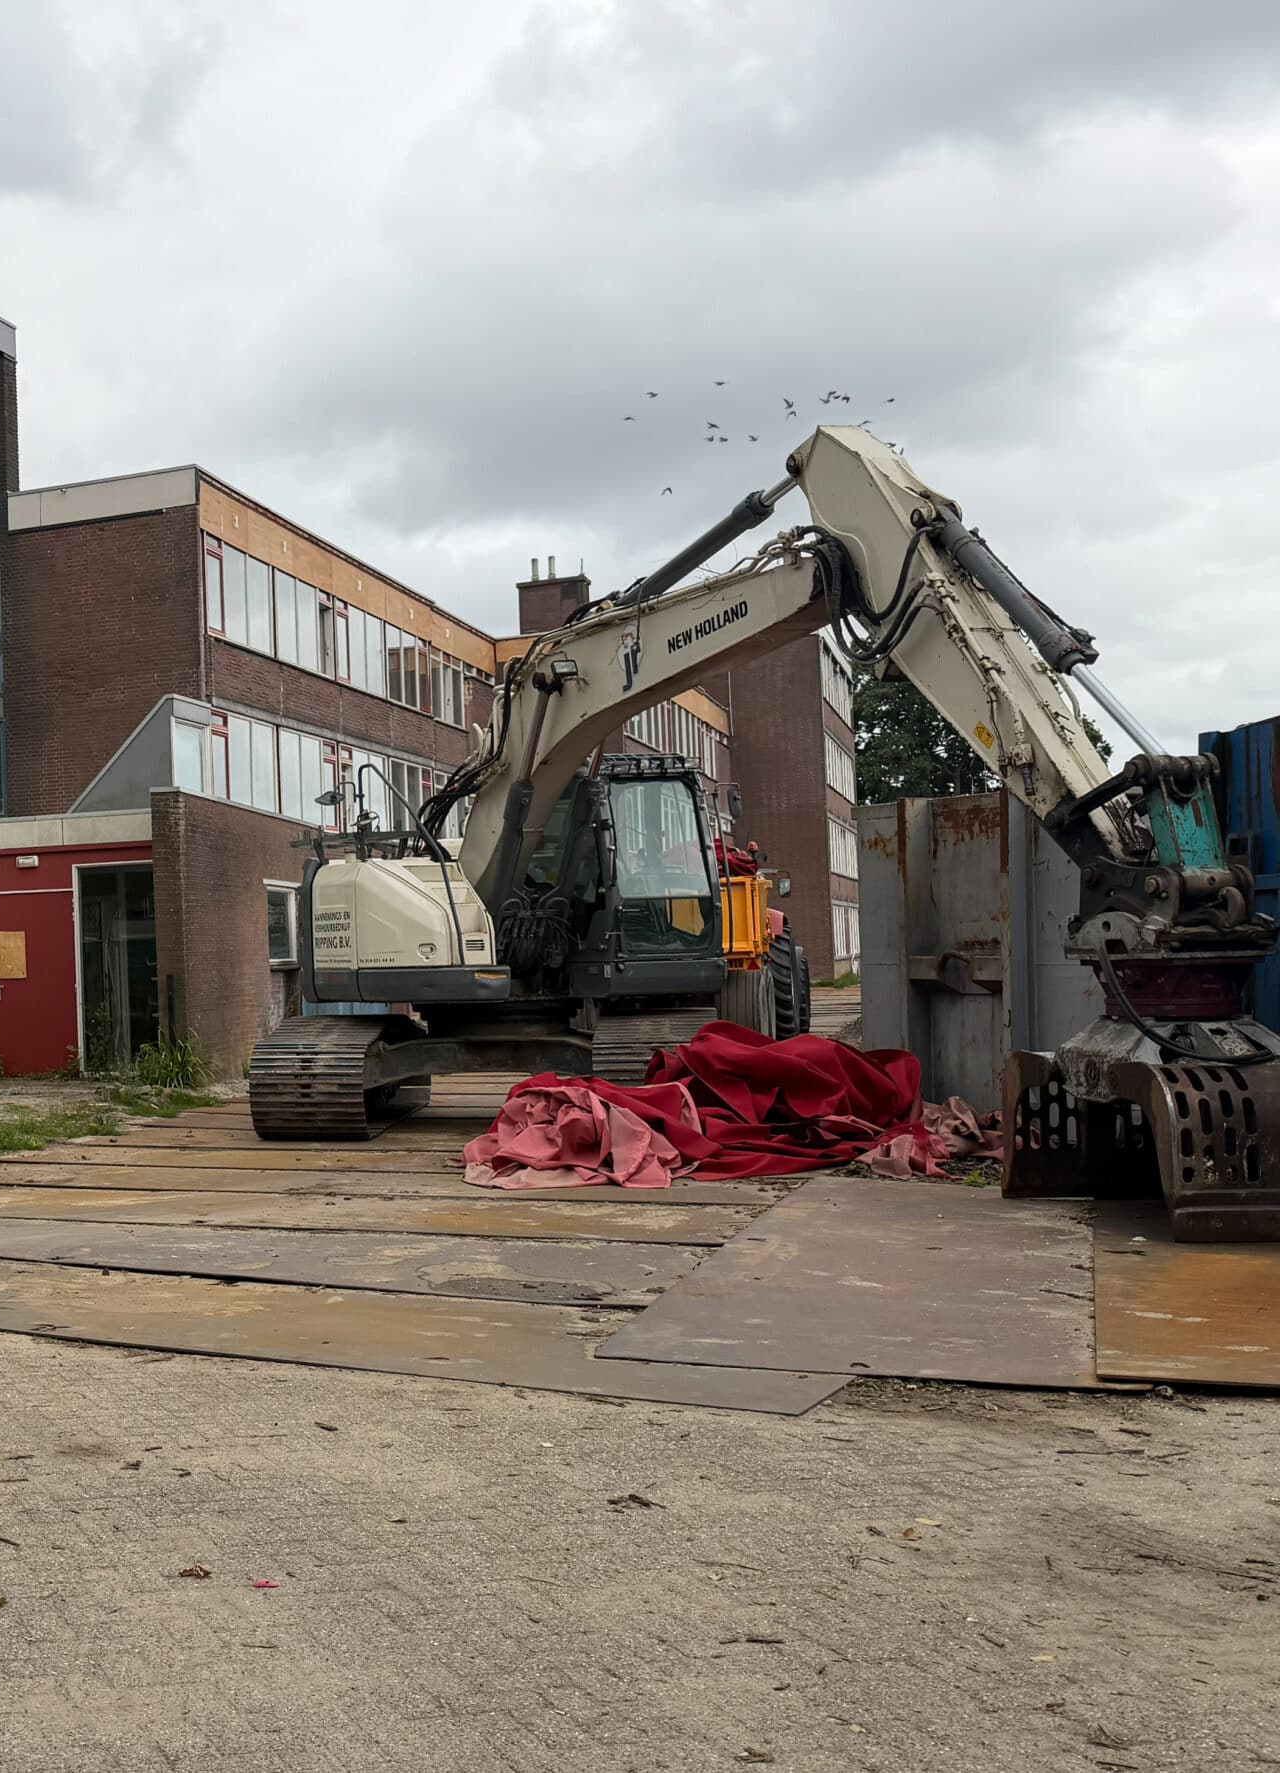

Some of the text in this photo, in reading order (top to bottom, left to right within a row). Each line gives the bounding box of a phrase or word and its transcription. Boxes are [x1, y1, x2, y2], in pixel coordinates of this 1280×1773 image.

[667, 600, 748, 654] NEW HOLLAND
[339, 935, 352, 948] B.V.
